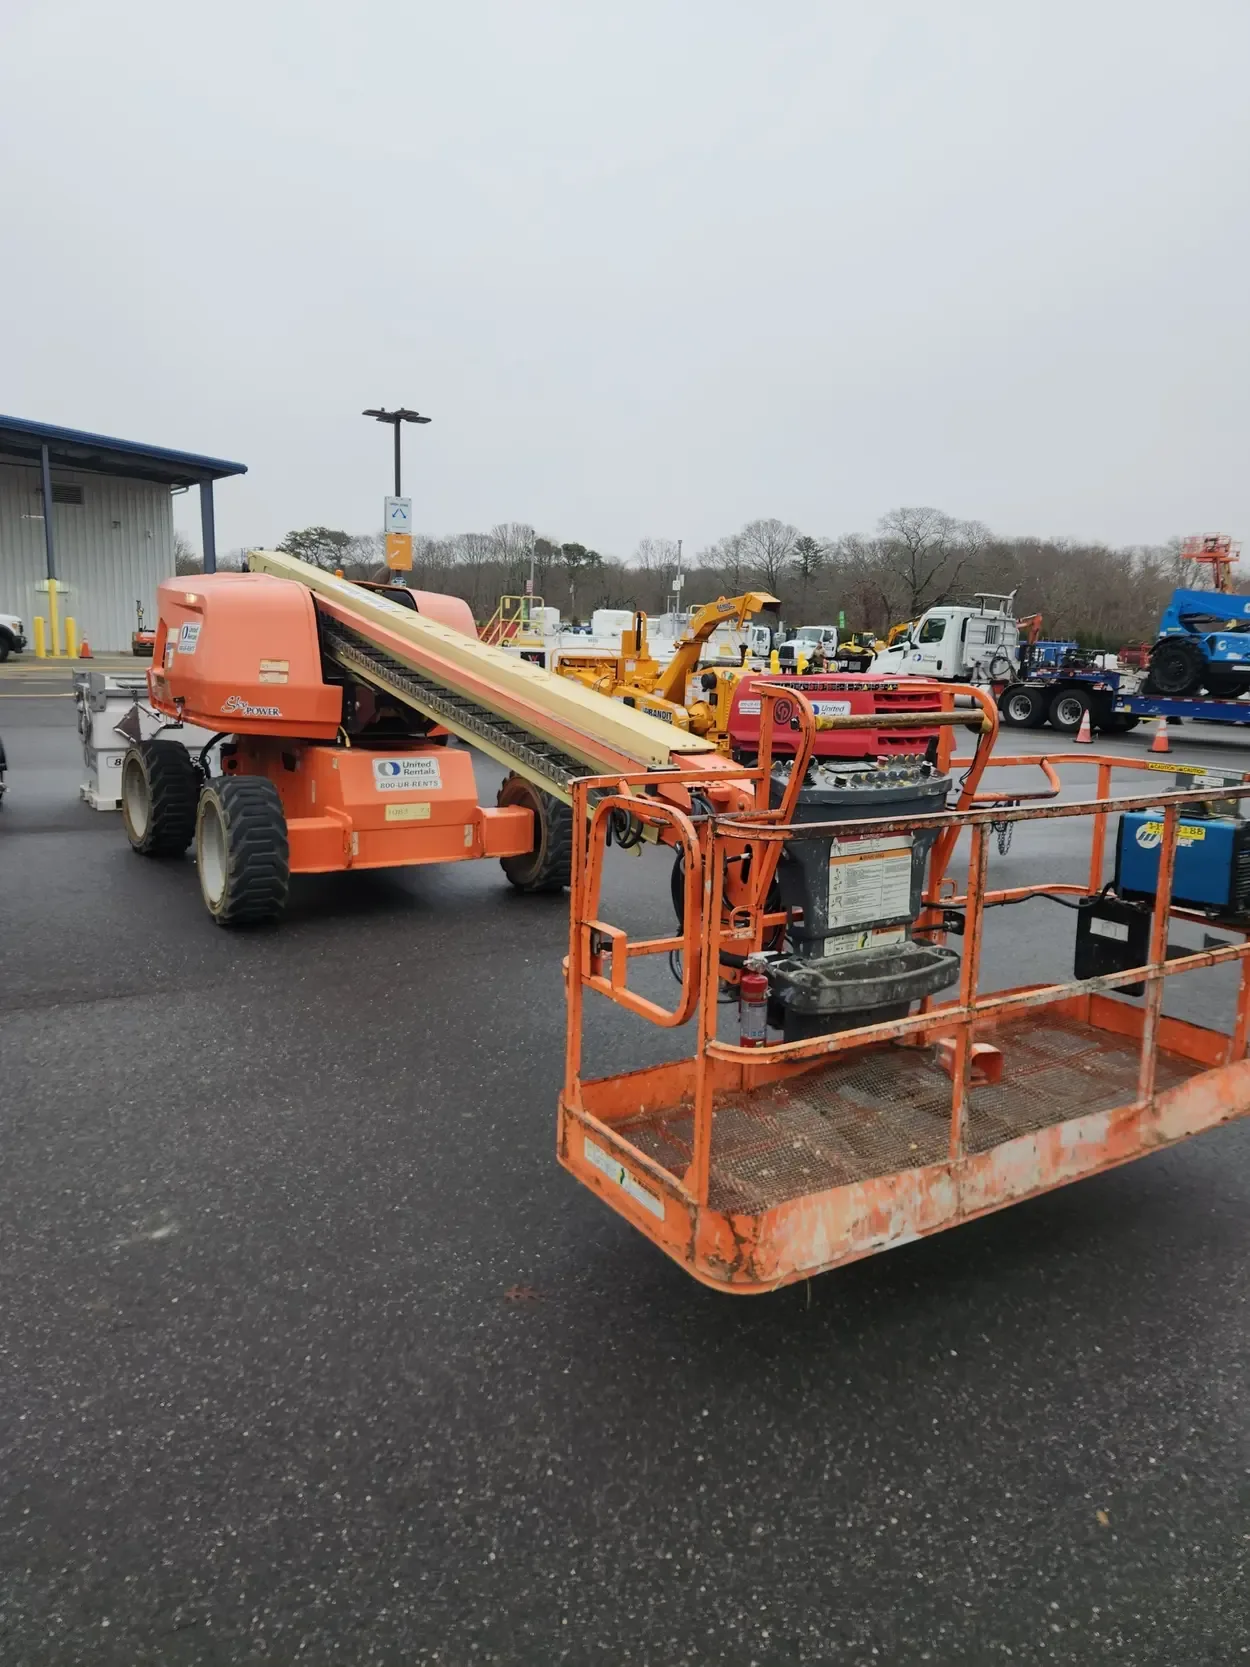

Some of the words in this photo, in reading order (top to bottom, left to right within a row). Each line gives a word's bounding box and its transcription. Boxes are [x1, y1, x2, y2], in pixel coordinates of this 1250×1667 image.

[245, 707, 280, 716] POWER
[820, 704, 846, 713] United
[402, 761, 432, 769] United
[403, 768, 436, 776] Rentals
[380, 780, 439, 789] 800-UR-RENTS
